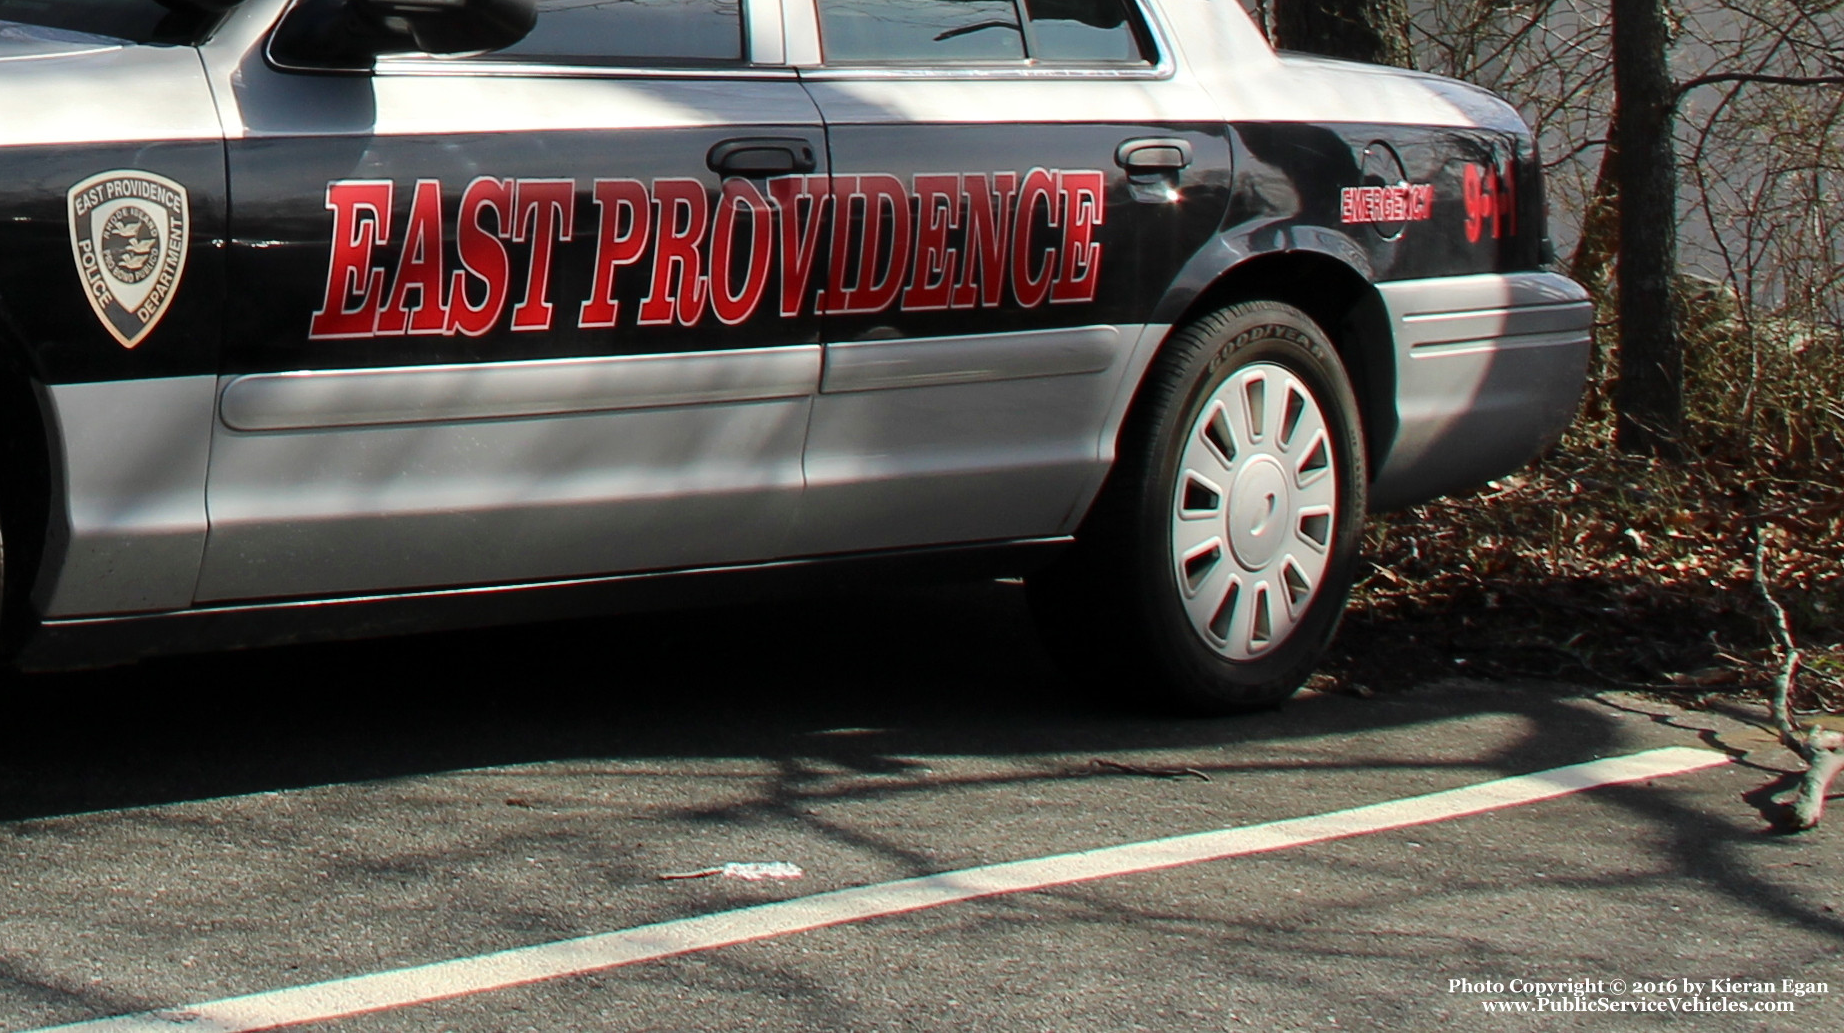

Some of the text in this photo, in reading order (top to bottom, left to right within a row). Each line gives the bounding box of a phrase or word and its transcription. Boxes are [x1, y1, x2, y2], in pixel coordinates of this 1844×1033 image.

[75, 179, 182, 216] EAST PROVIDENCE
[104, 208, 158, 240] RHODE ISLAND
[1341, 183, 1435, 224] EMERGENCY
[79, 239, 113, 309] POLICE
[137, 217, 183, 324] DEPARTMENT
[308, 167, 1106, 340] EAST PROVIDENCE
